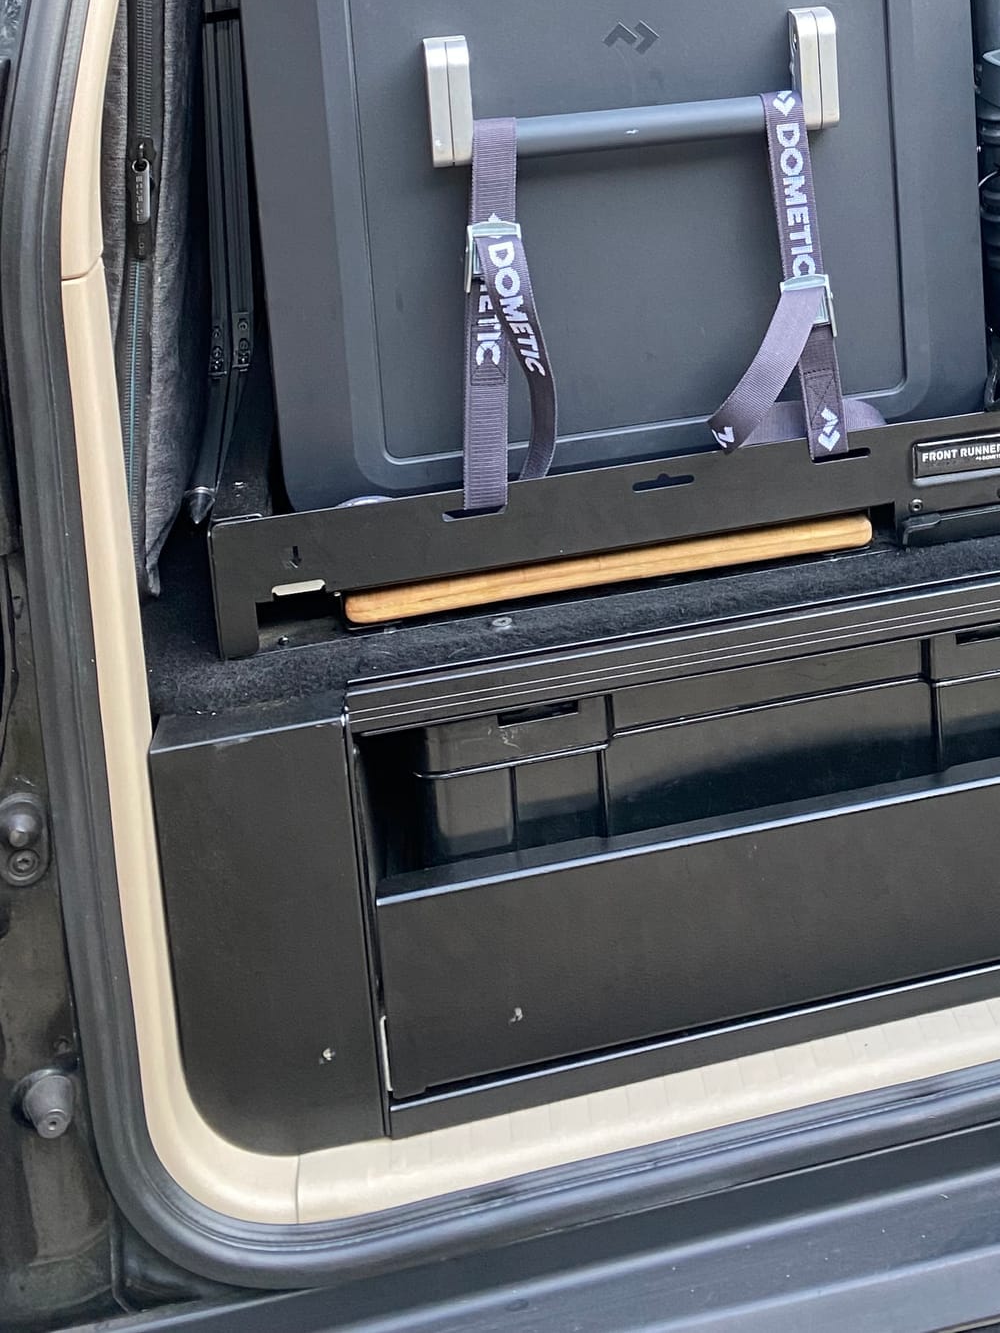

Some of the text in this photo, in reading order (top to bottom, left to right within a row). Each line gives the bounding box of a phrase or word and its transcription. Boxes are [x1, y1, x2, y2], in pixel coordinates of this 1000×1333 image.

[775, 122, 816, 278] DOMETIC
[487, 240, 546, 377] DOMETIC
[922, 449, 958, 463] FRONT
